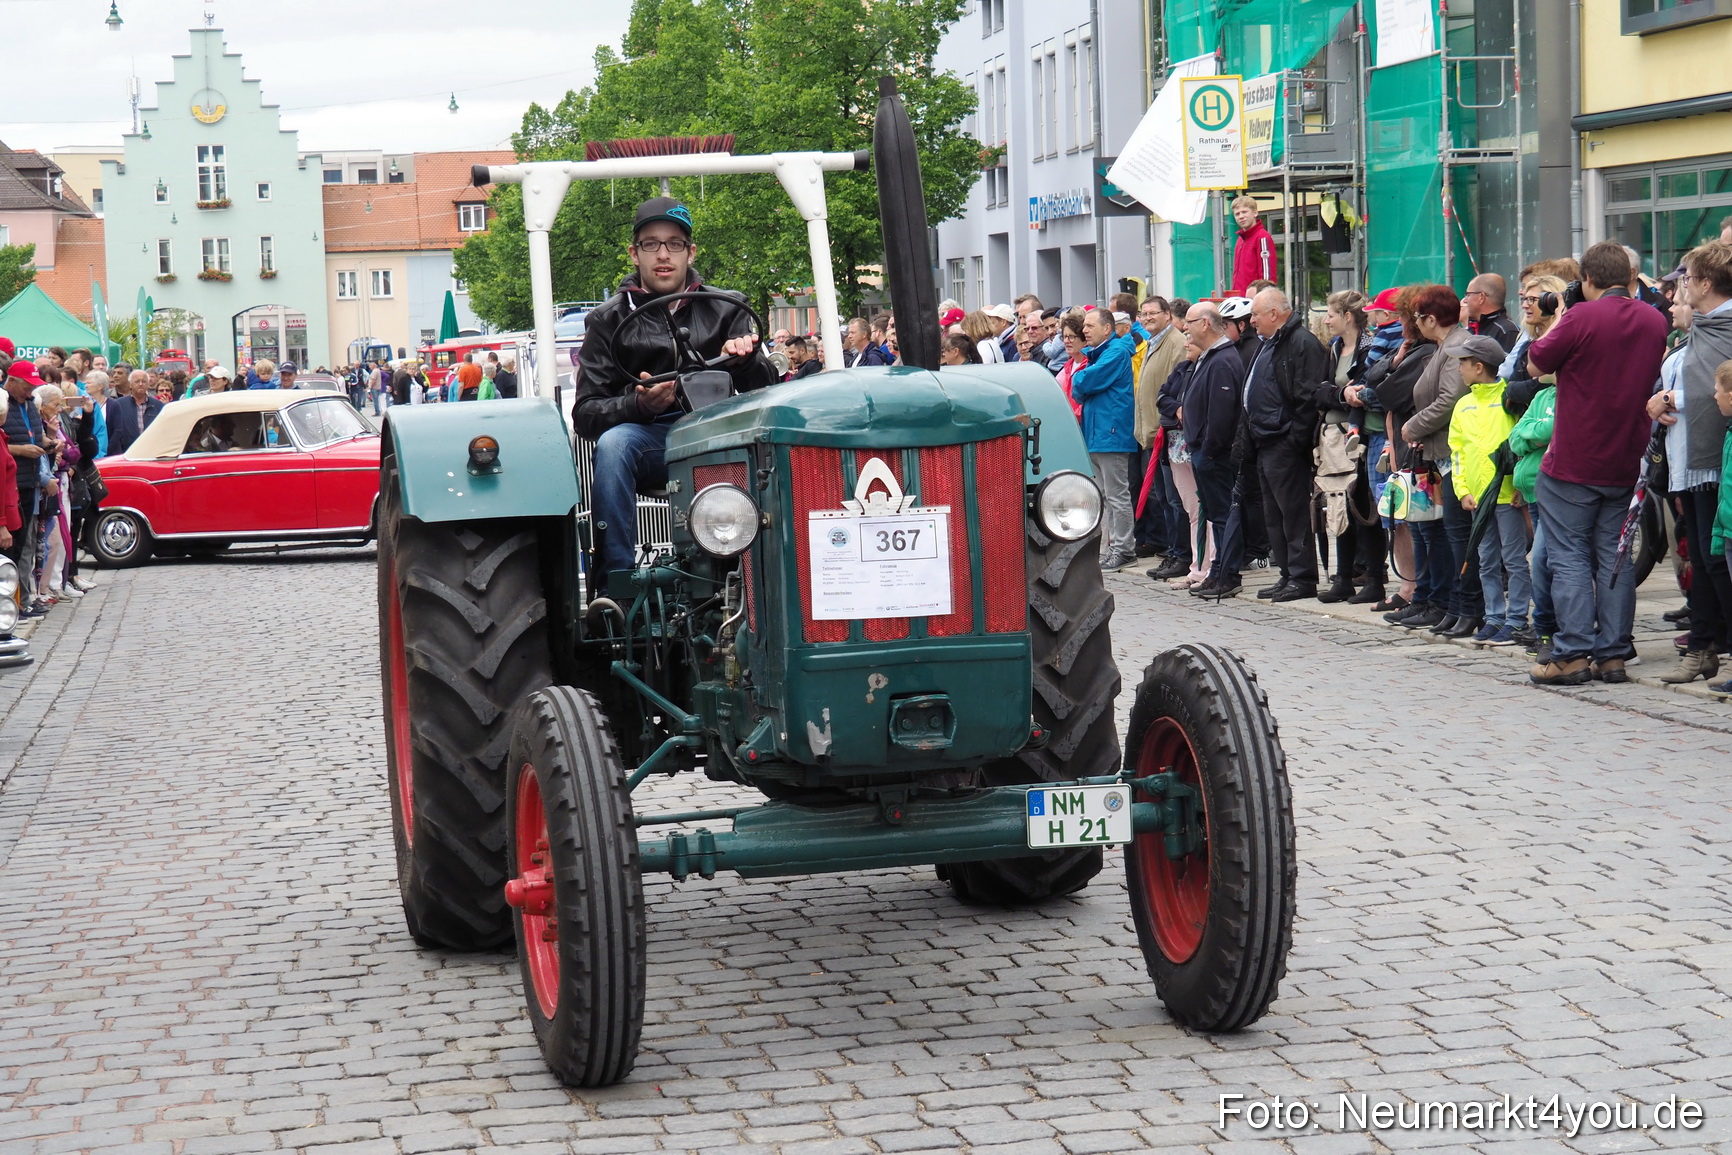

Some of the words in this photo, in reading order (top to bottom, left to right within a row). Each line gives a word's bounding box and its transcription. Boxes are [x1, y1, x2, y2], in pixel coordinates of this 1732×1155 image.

[1202, 95, 1221, 121] H
[1249, 118, 1271, 140] Velburg
[1040, 187, 1091, 220] Raiffeisenbank
[17, 347, 49, 358] DEKR
[876, 529, 920, 552] 367
[1052, 792, 1084, 815] NM
[1048, 820, 1064, 843] H
[1080, 818, 1110, 841] 21
